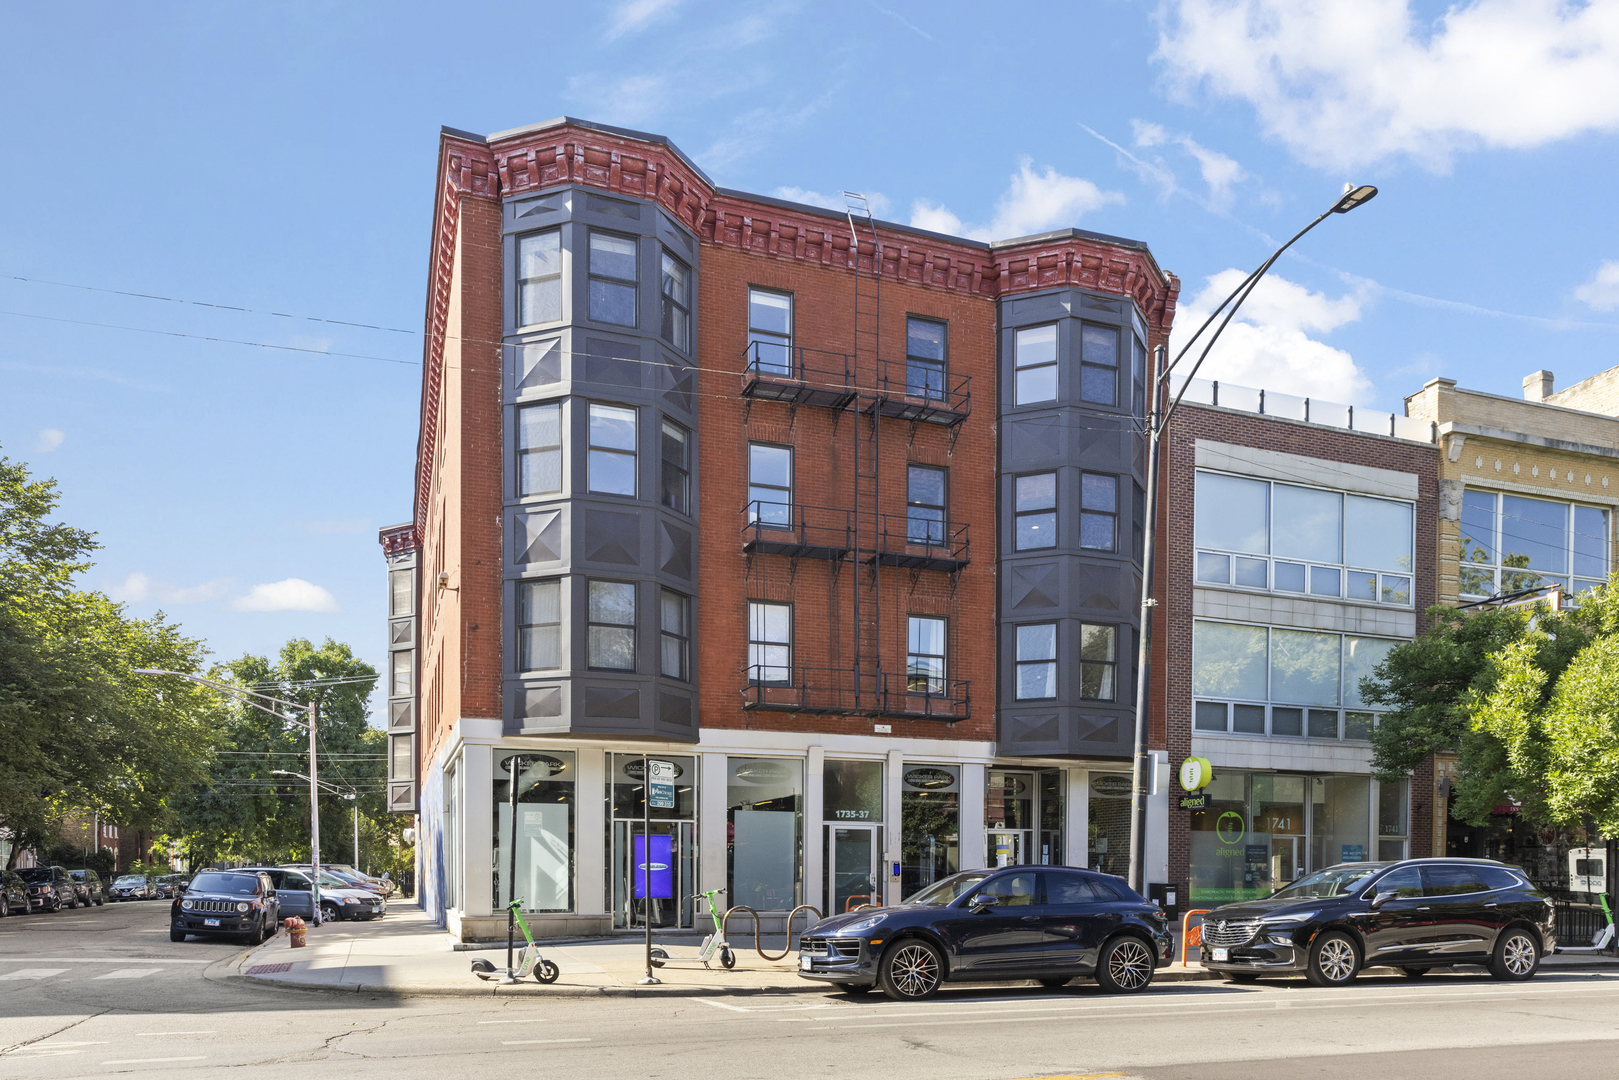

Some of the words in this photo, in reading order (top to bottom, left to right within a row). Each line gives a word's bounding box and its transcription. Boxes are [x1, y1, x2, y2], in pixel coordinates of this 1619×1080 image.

[1524, 598, 1551, 612] ROM
[1180, 796, 1204, 808] aligned
[836, 810, 870, 818] 1735-37
[1267, 817, 1291, 830] 1741
[1216, 847, 1245, 858] aligned
